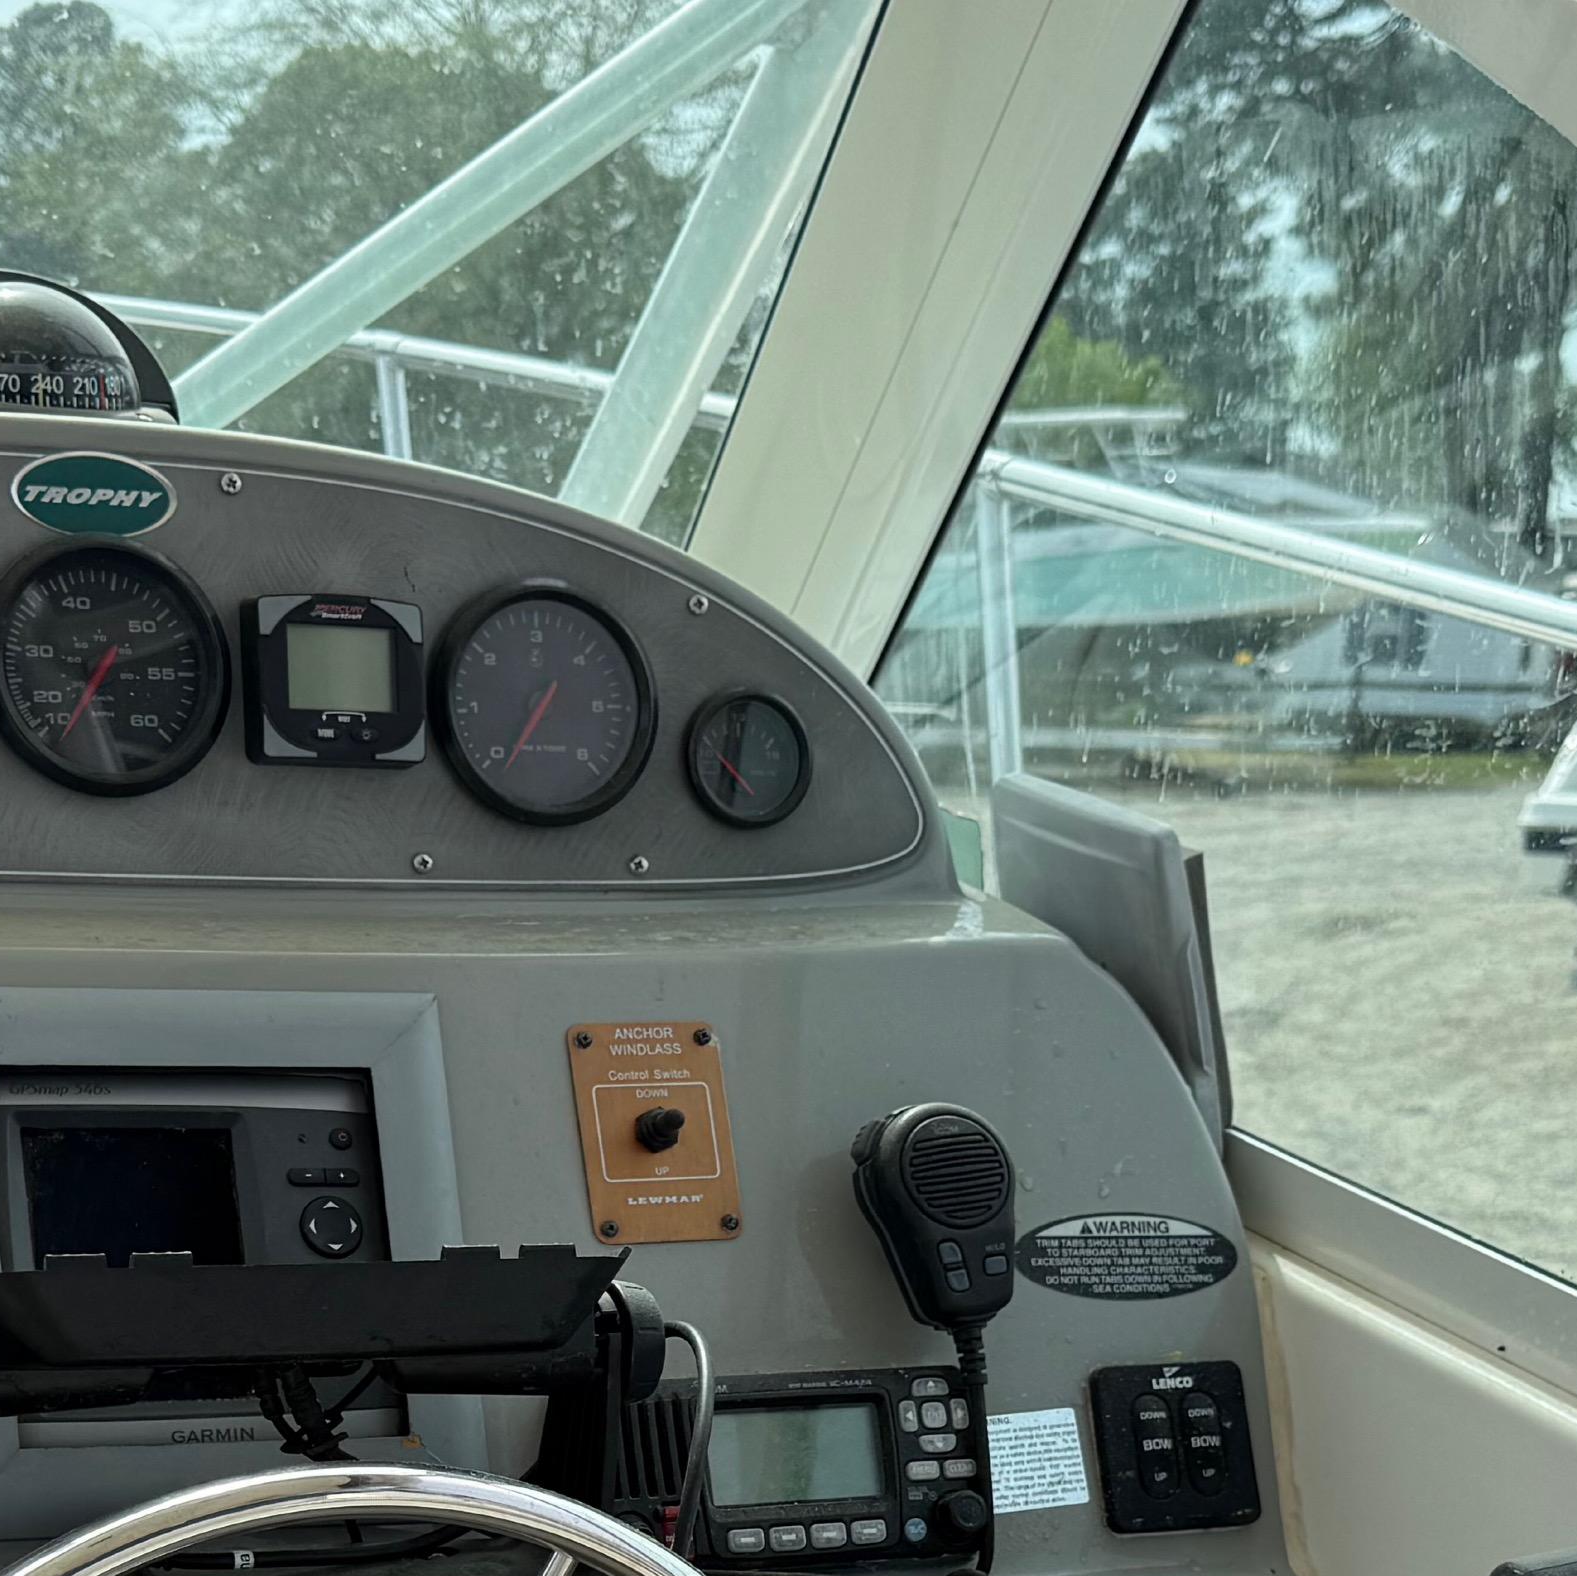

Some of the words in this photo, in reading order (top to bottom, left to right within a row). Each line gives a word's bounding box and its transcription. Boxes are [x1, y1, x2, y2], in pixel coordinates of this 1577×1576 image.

[31, 376, 63, 394] 240
[74, 377, 98, 394] 210
[25, 486, 162, 507] TROPHY
[62, 597, 91, 609] 40
[128, 620, 156, 633] 50
[530, 630, 543, 643] 3
[25, 645, 54, 658] 30
[484, 653, 496, 665] 2
[147, 668, 175, 681] 55
[33, 691, 62, 704] 20
[130, 715, 159, 728] 60
[615, 1028, 673, 1039] ANCHOR
[610, 1043, 682, 1056] WINDLASS
[608, 1070, 649, 1081] Control
[654, 1069, 690, 1079] Switch
[636, 1088, 668, 1098] DOWN
[655, 1167, 670, 1176] UP
[1093, 1221, 1169, 1234] WARNING
[1152, 1377, 1193, 1389] LENCO
[1140, 1411, 1166, 1420] DOWN
[1188, 1408, 1214, 1418] DOWN
[171, 1427, 255, 1444] GARMIN
[1143, 1438, 1172, 1451] BOW
[1191, 1435, 1220, 1448] BOW
[1154, 1471, 1167, 1481] UP
[1202, 1468, 1215, 1477] UP
